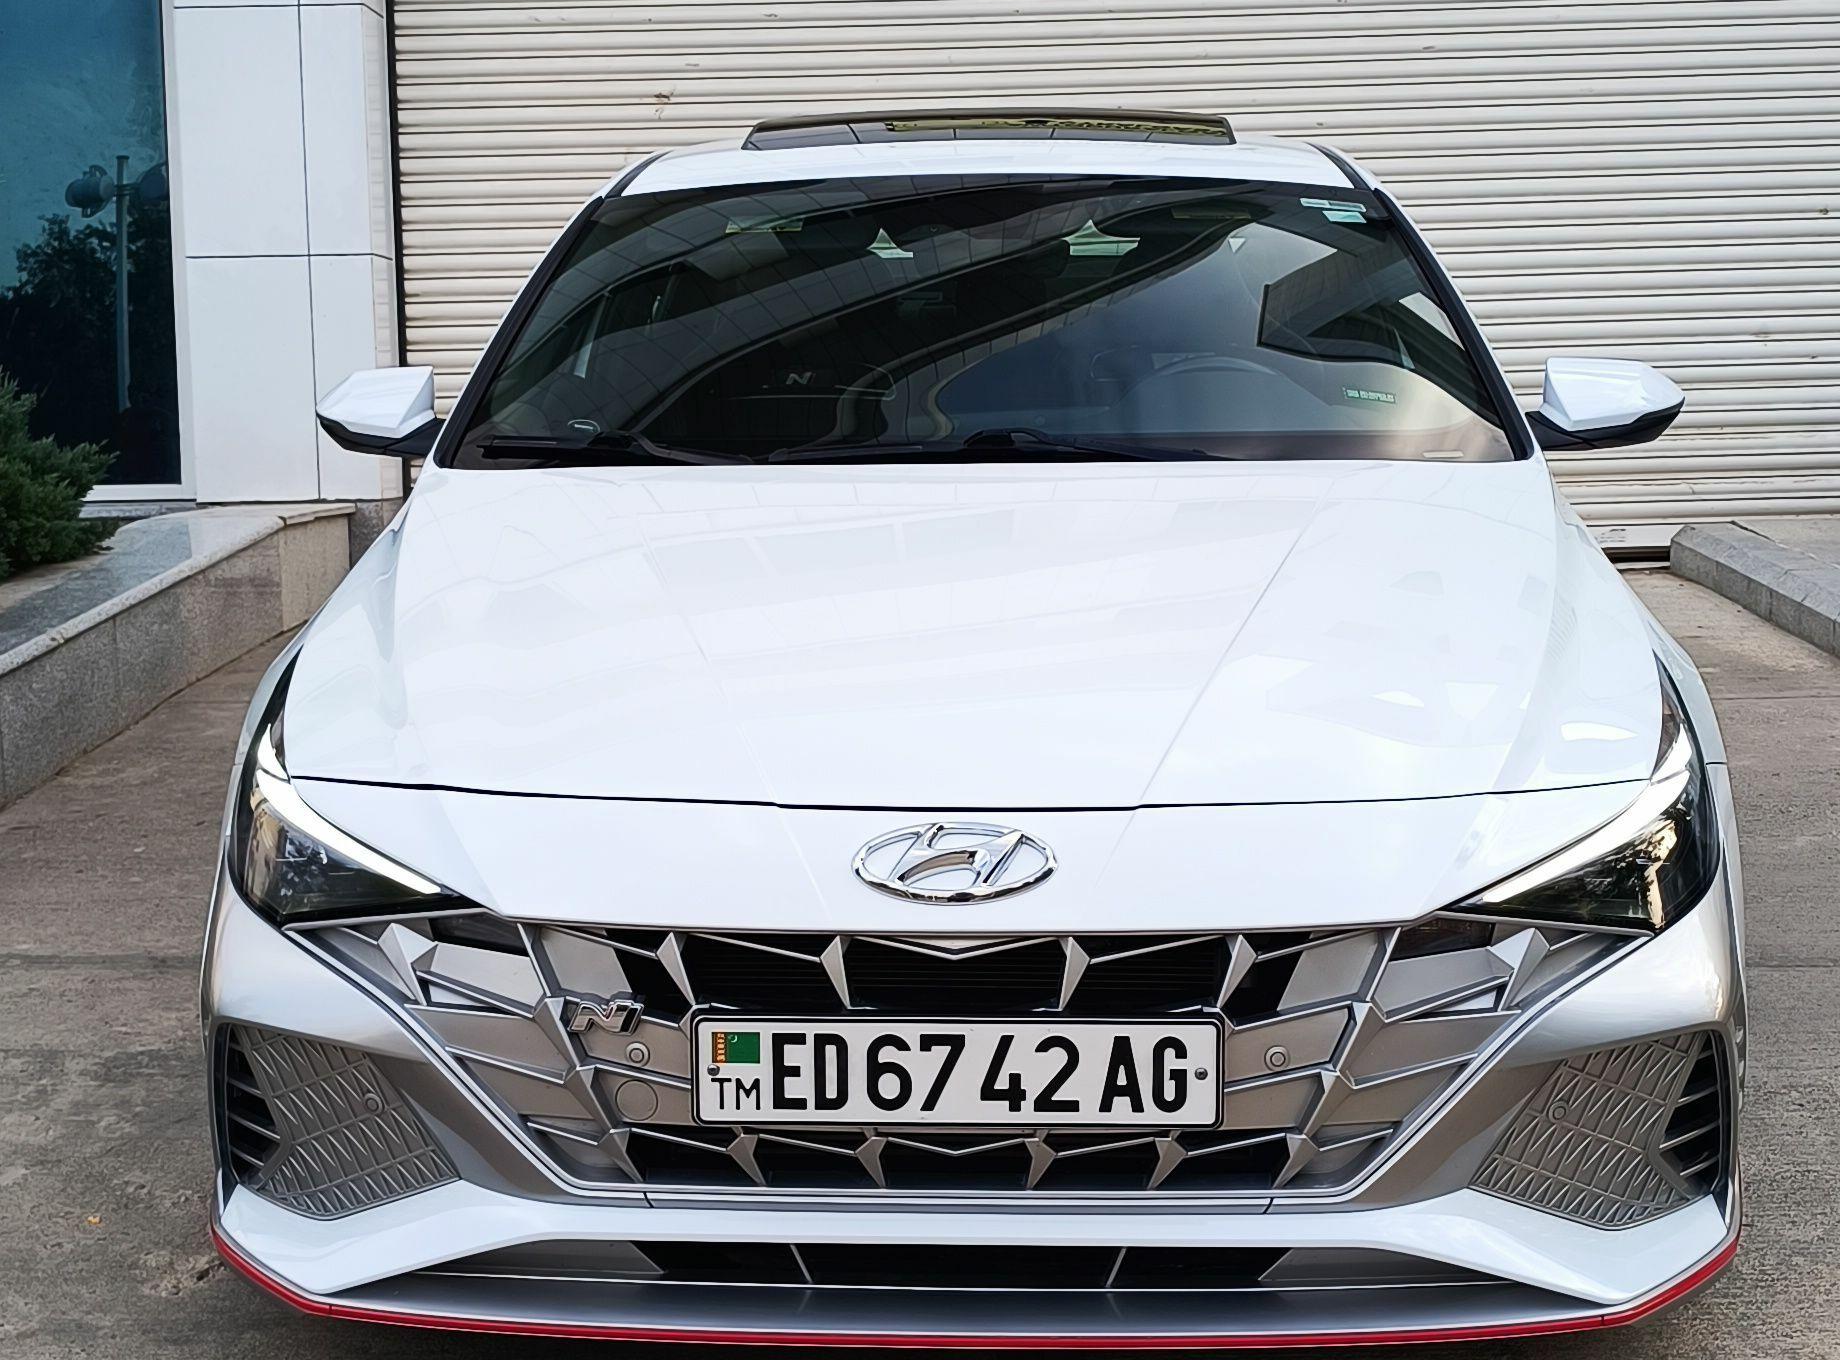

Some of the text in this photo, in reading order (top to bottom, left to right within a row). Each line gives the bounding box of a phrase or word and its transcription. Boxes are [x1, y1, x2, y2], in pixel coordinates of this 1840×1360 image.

[711, 1077, 761, 1110] TM
[771, 1032, 850, 1111] ED
[1099, 1035, 1188, 1114] AG
